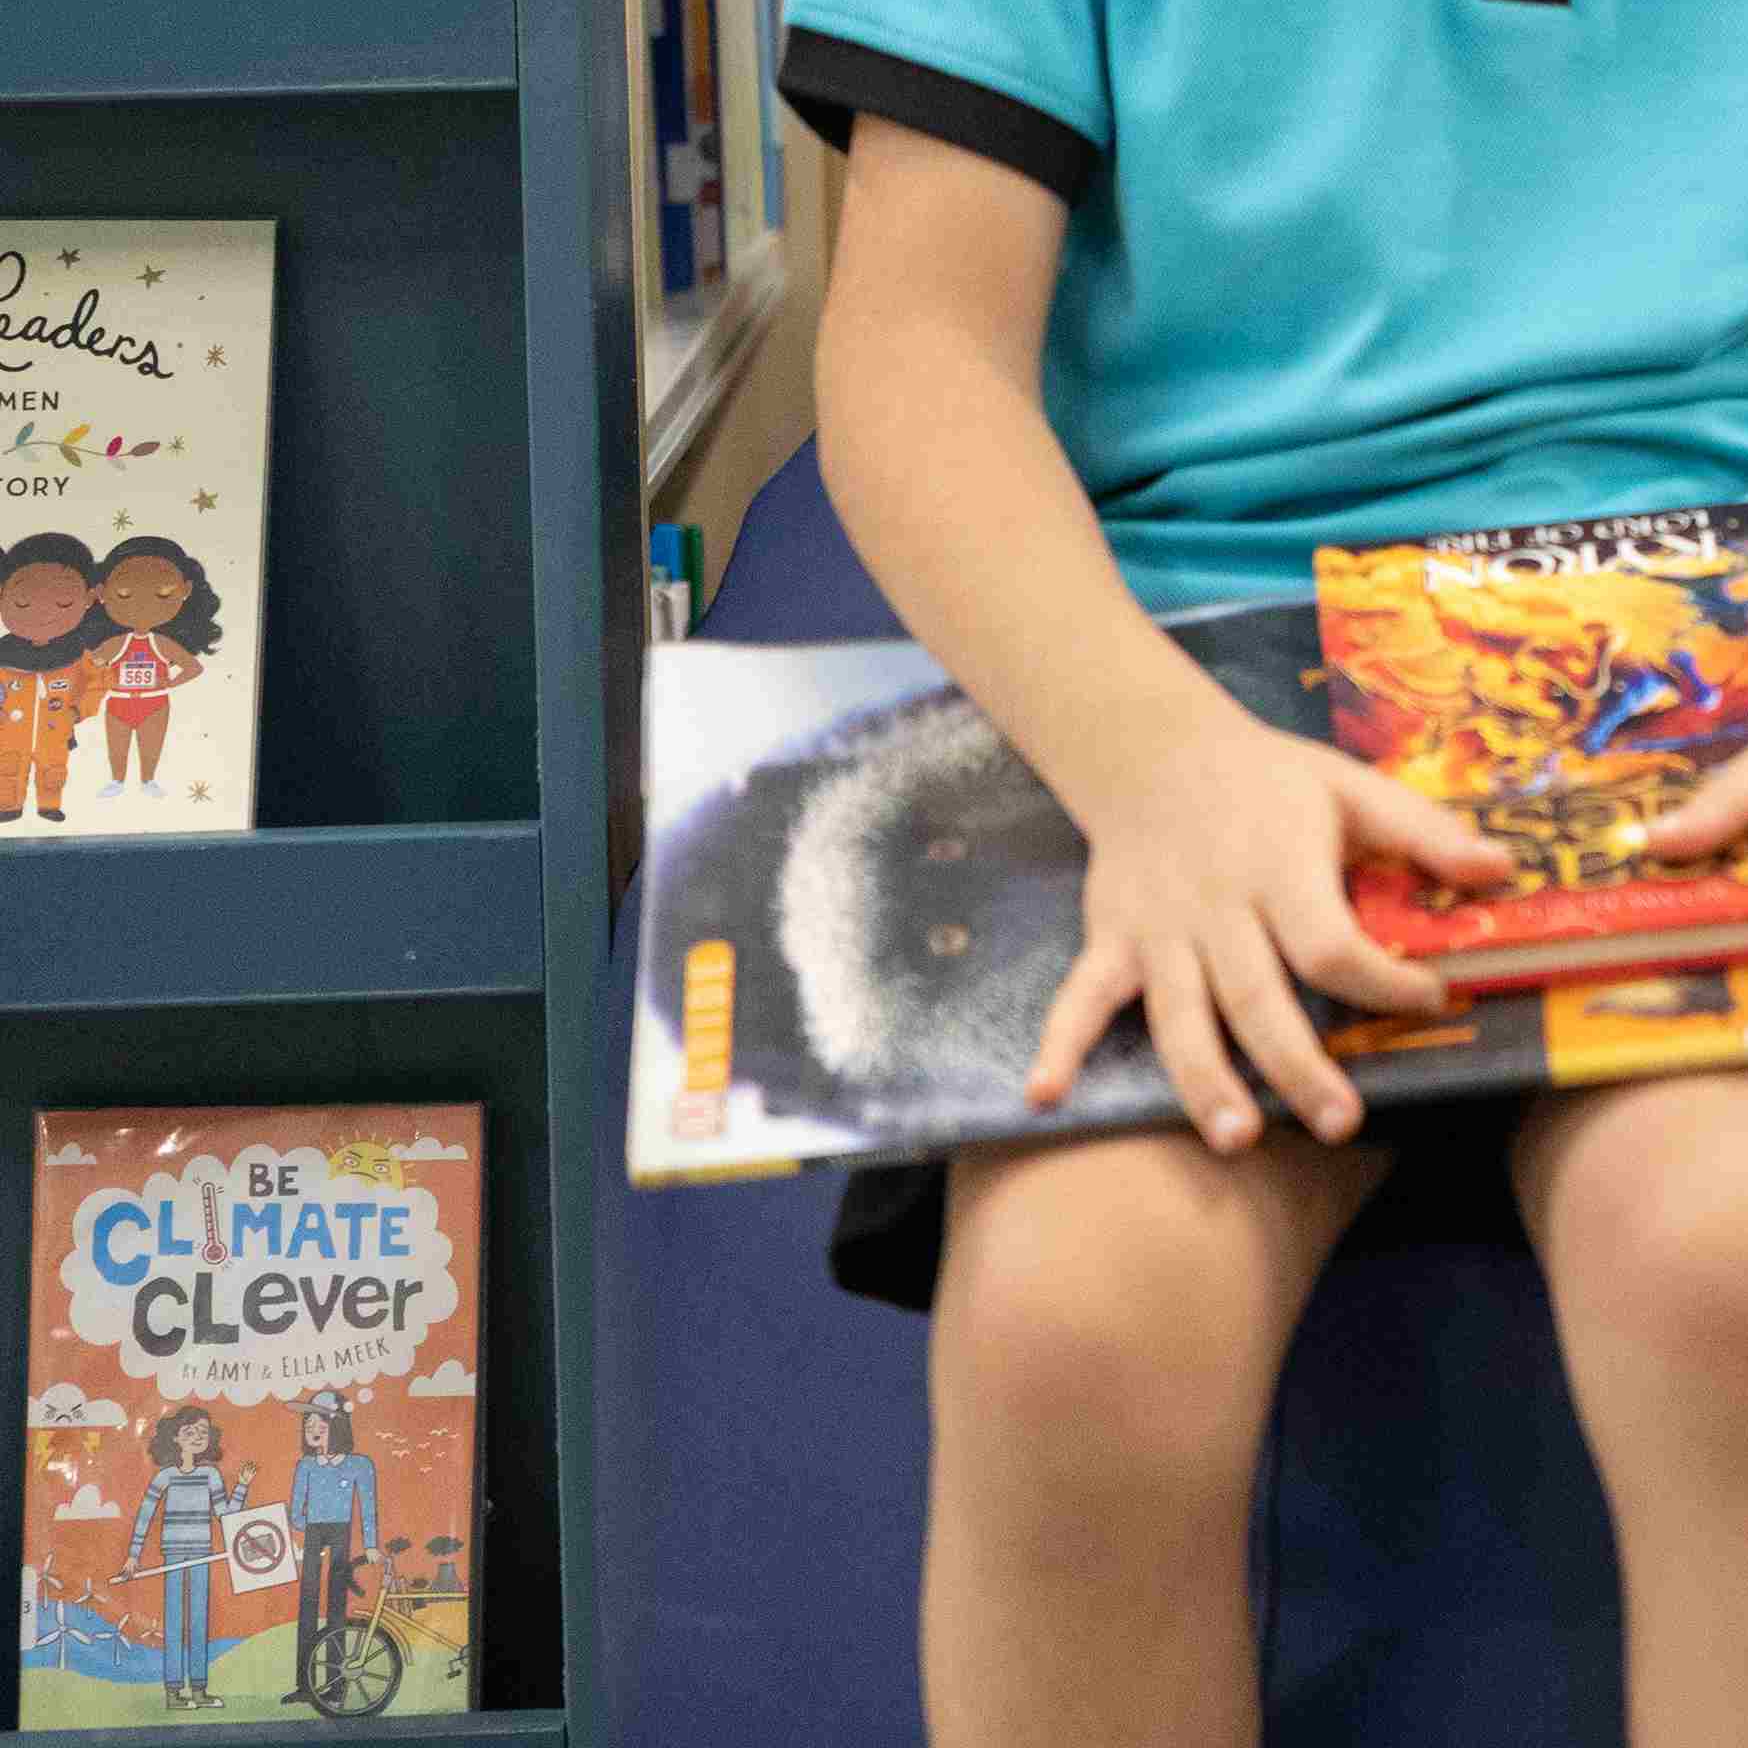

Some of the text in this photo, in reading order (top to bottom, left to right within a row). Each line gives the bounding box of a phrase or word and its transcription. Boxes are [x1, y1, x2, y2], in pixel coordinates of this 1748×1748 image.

[0, 476, 71, 497] ORY
[125, 670, 153, 684] 569
[249, 1163, 300, 1198] BE
[206, 1359, 252, 1383] AMY
[281, 1353, 326, 1379] ELLA
[334, 1338, 391, 1369] MEEK
